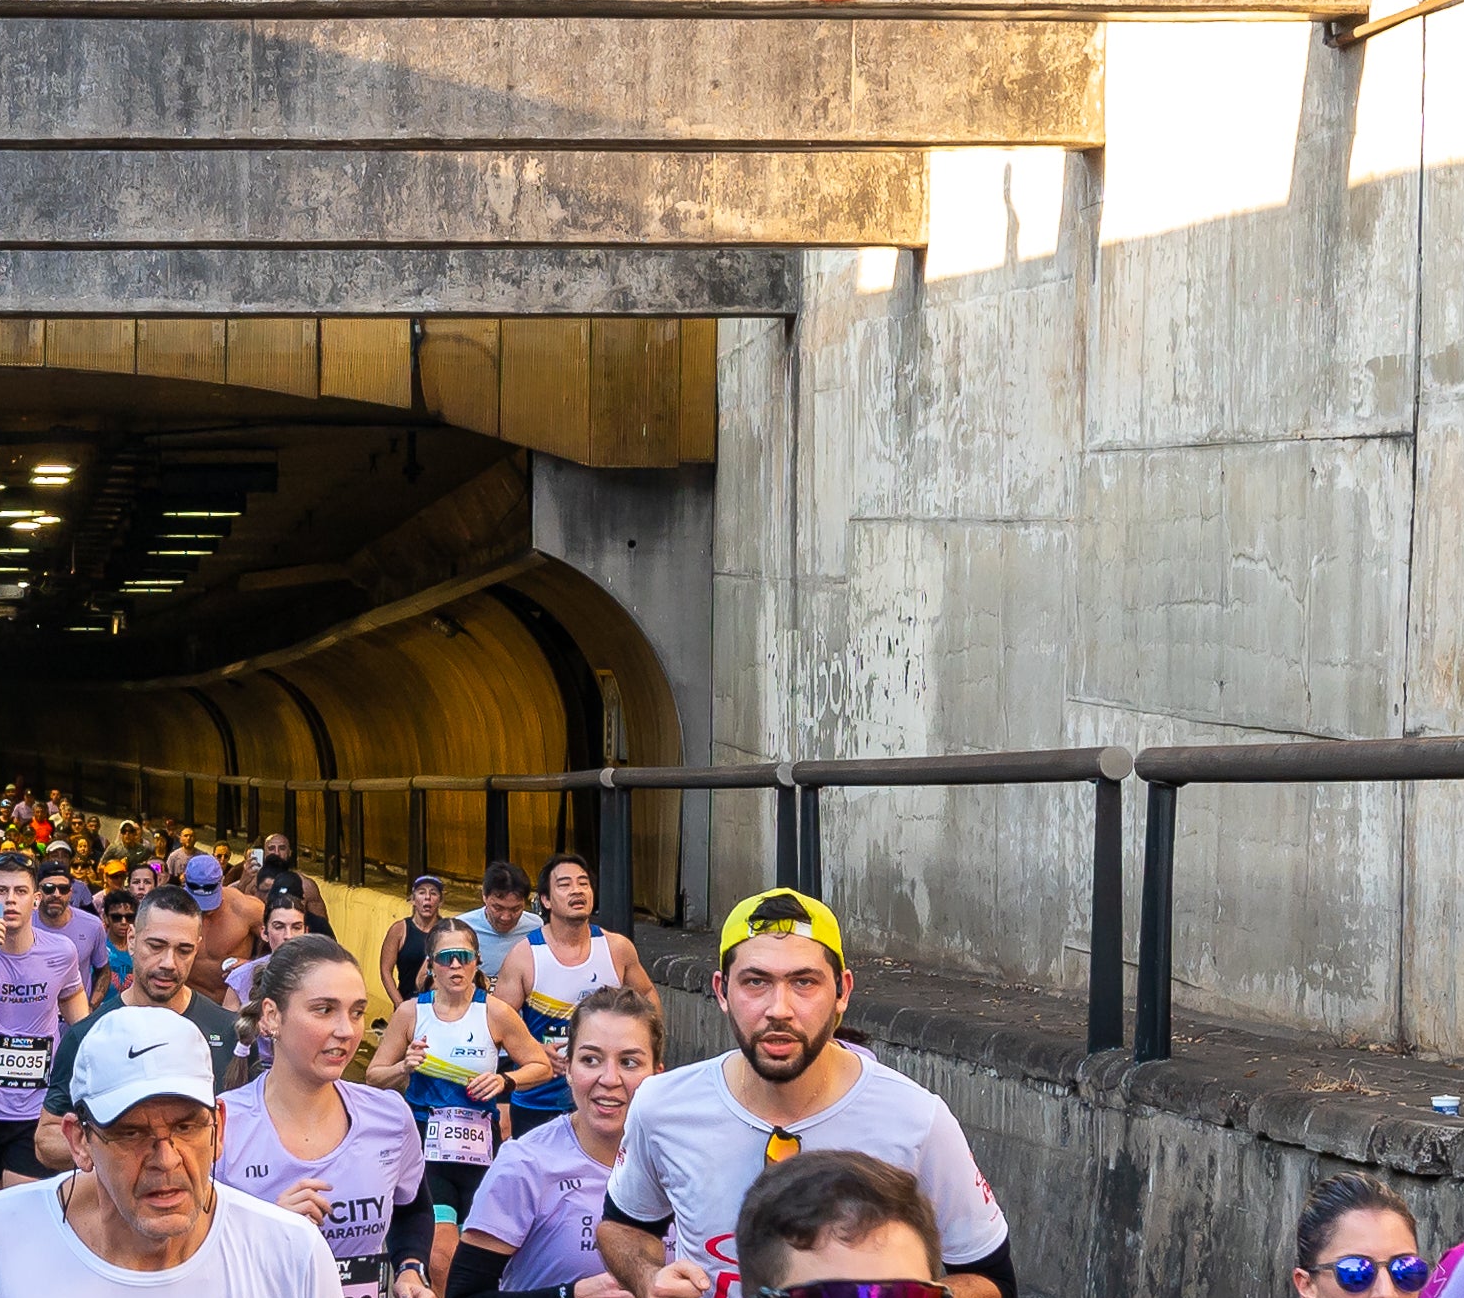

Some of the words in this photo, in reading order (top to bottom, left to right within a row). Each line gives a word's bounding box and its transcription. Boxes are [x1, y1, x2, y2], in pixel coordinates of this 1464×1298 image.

[2, 982, 48, 996] SPCITY
[9, 995, 48, 1004] MARATHON
[454, 1048, 485, 1056] RRT
[430, 1125, 436, 1136] D
[444, 1126, 485, 1142] 25864
[328, 1195, 385, 1224] CITY
